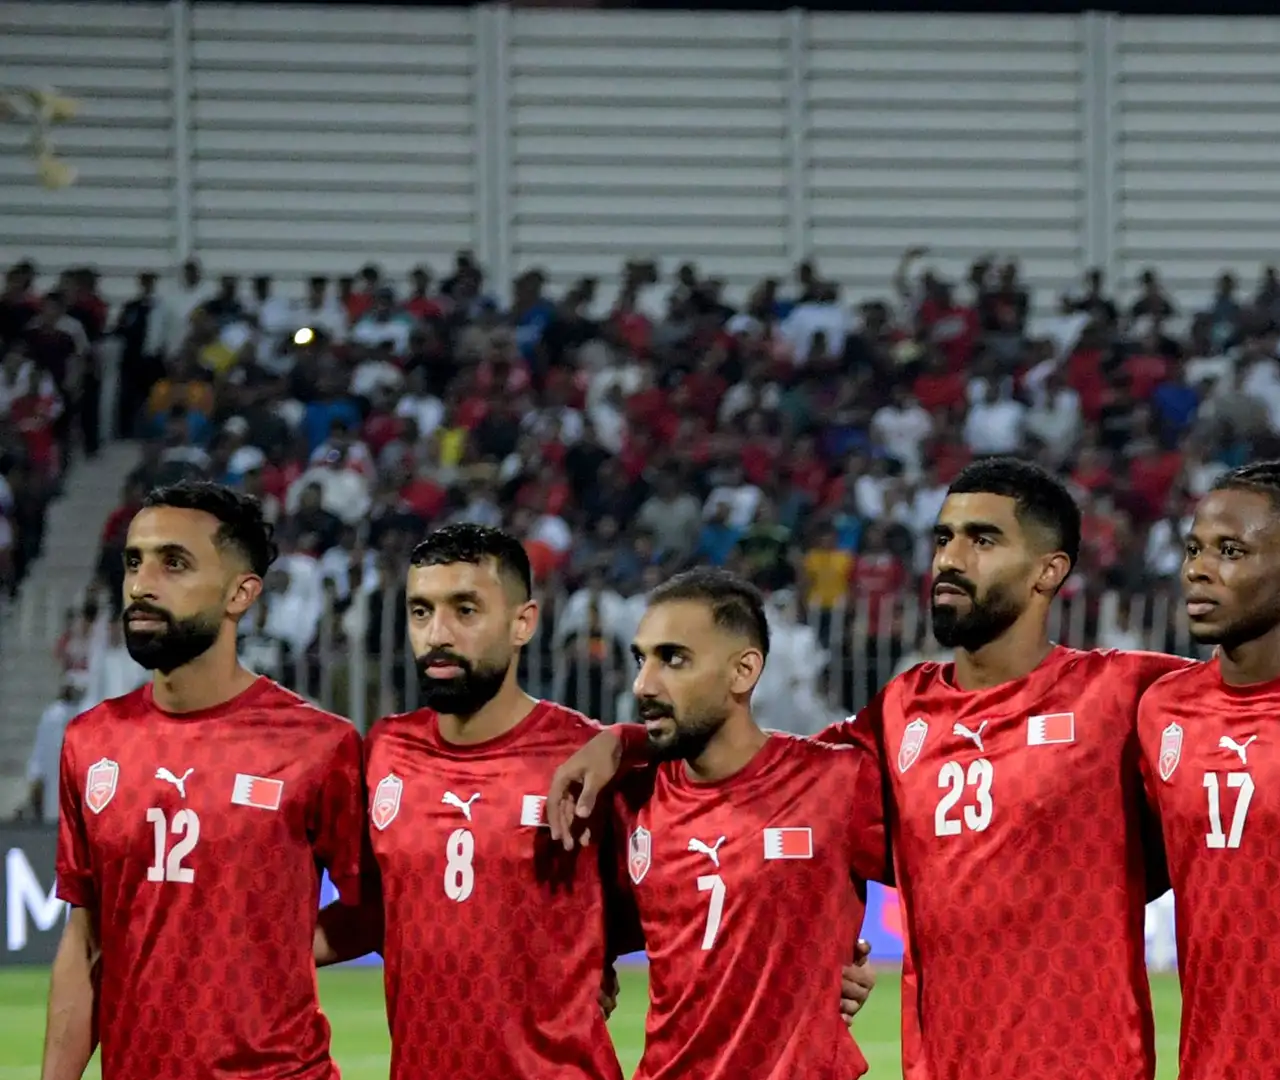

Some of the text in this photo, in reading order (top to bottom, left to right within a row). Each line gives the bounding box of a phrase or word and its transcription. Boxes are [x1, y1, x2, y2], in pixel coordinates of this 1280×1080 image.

[934, 758, 994, 837] 23
[1202, 771, 1255, 849] 17
[146, 807, 201, 884] 12
[443, 828, 475, 902] 8
[697, 874, 727, 951] 7
